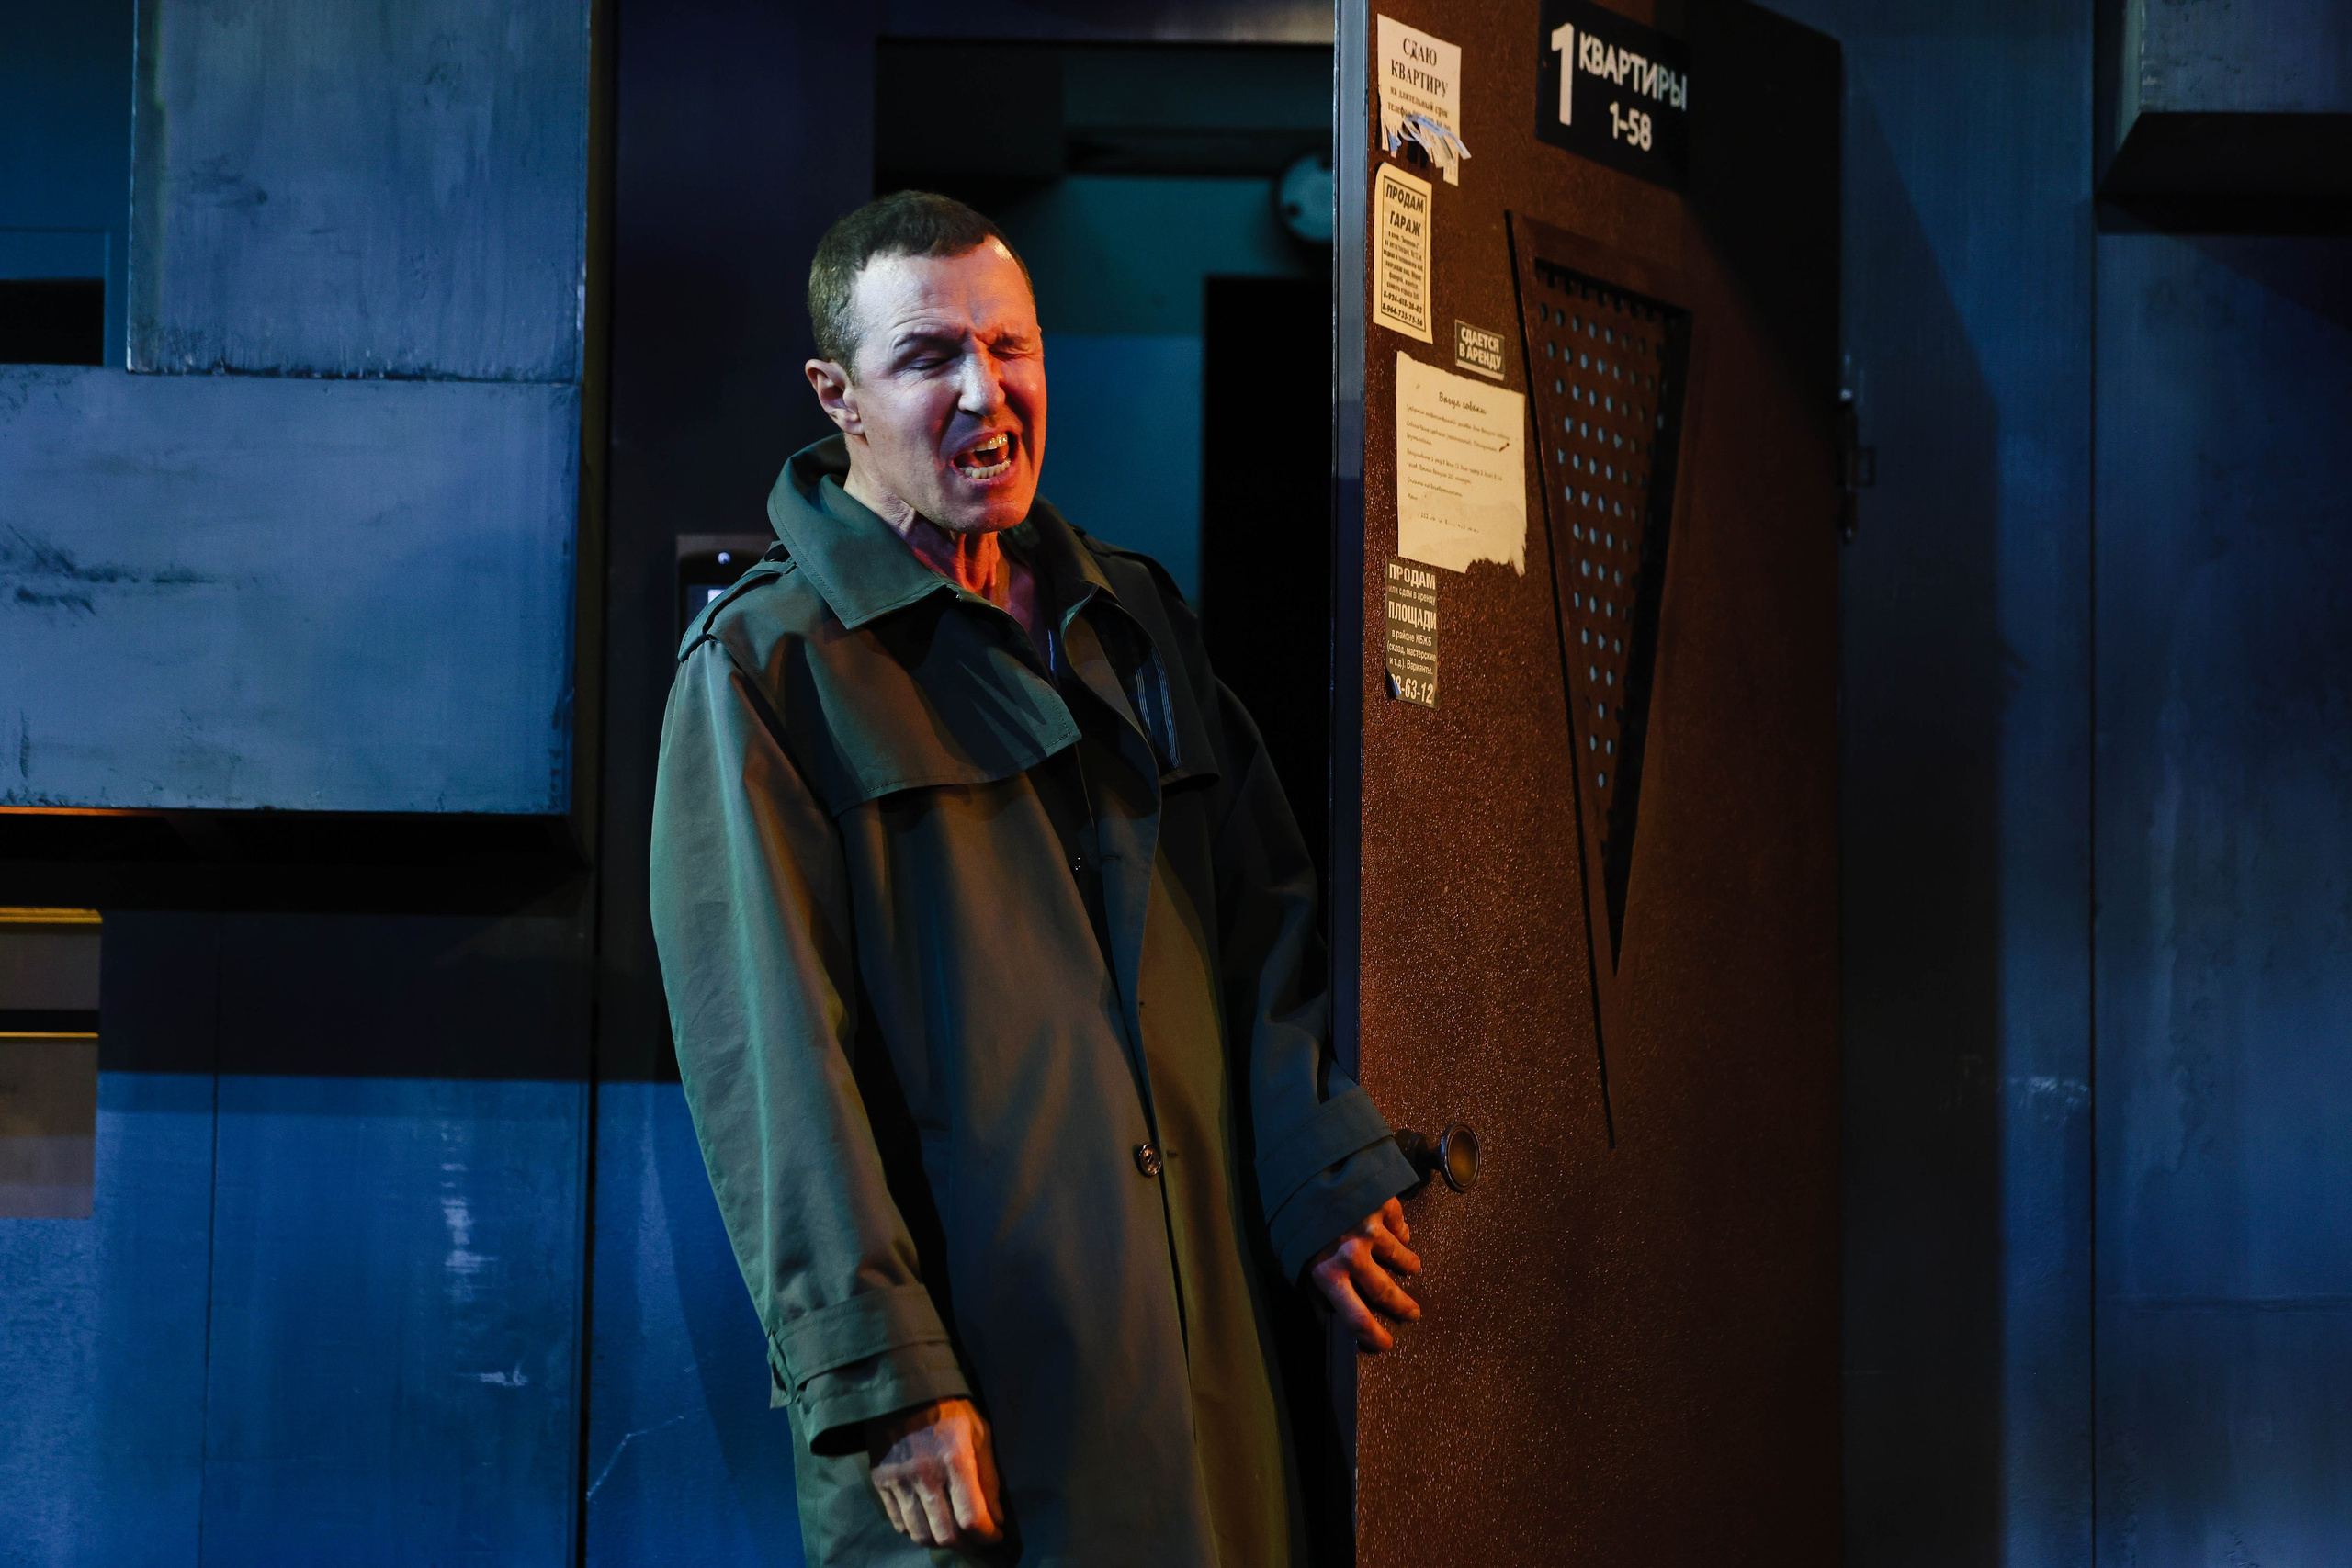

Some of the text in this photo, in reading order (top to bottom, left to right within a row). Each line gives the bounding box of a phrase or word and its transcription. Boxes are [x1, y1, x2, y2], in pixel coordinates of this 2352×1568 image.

[1402, 37, 1437, 66] СДАЮ
[1390, 58, 1449, 97] КВАРТИРУ
[1551, 22, 1575, 127] 1
[1578, 31, 1687, 112] КВАРТИРЫ
[1398, 90, 1434, 111] длительный
[1609, 101, 1652, 152] 1-58
[1385, 183, 1423, 214] ПРОДАМ
[1390, 210, 1421, 237] ГАРАЖ
[1460, 326, 1499, 354] СДАЕТСЯ
[1459, 342, 1502, 370] В АРЕНДУ
[1388, 562, 1436, 591] ПРОДАМ
[1398, 587, 1413, 600] сдам
[1418, 592, 1436, 606] аренду
[1387, 600, 1437, 632] ПЛОЩАДИ
[1391, 628, 1396, 637] в
[1396, 629, 1415, 642] районе
[1406, 647, 1437, 662] мастерские
